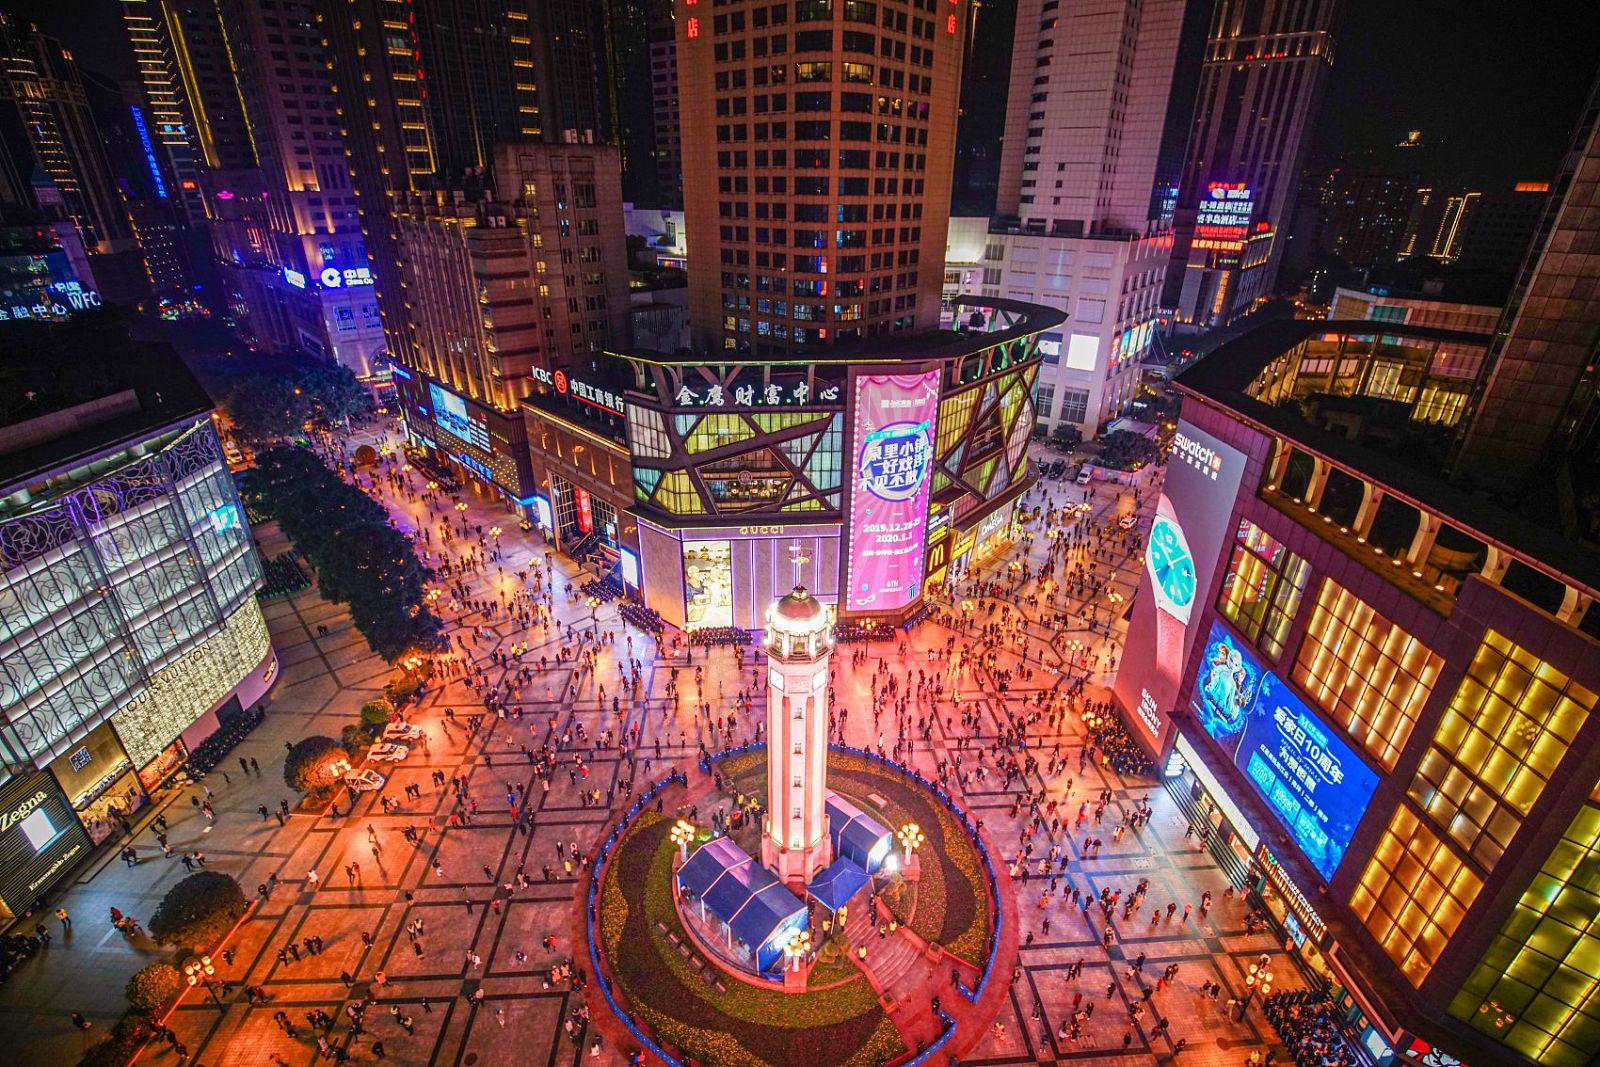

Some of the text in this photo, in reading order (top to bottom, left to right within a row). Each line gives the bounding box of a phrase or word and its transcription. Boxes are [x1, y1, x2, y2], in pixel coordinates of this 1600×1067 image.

[532, 365, 553, 385] ICBC
[569, 378, 625, 413] 中国工商银行
[675, 381, 840, 407] 金鹰财富中心
[1174, 432, 1214, 467] swatch
[0, 790, 48, 833] Zegna
